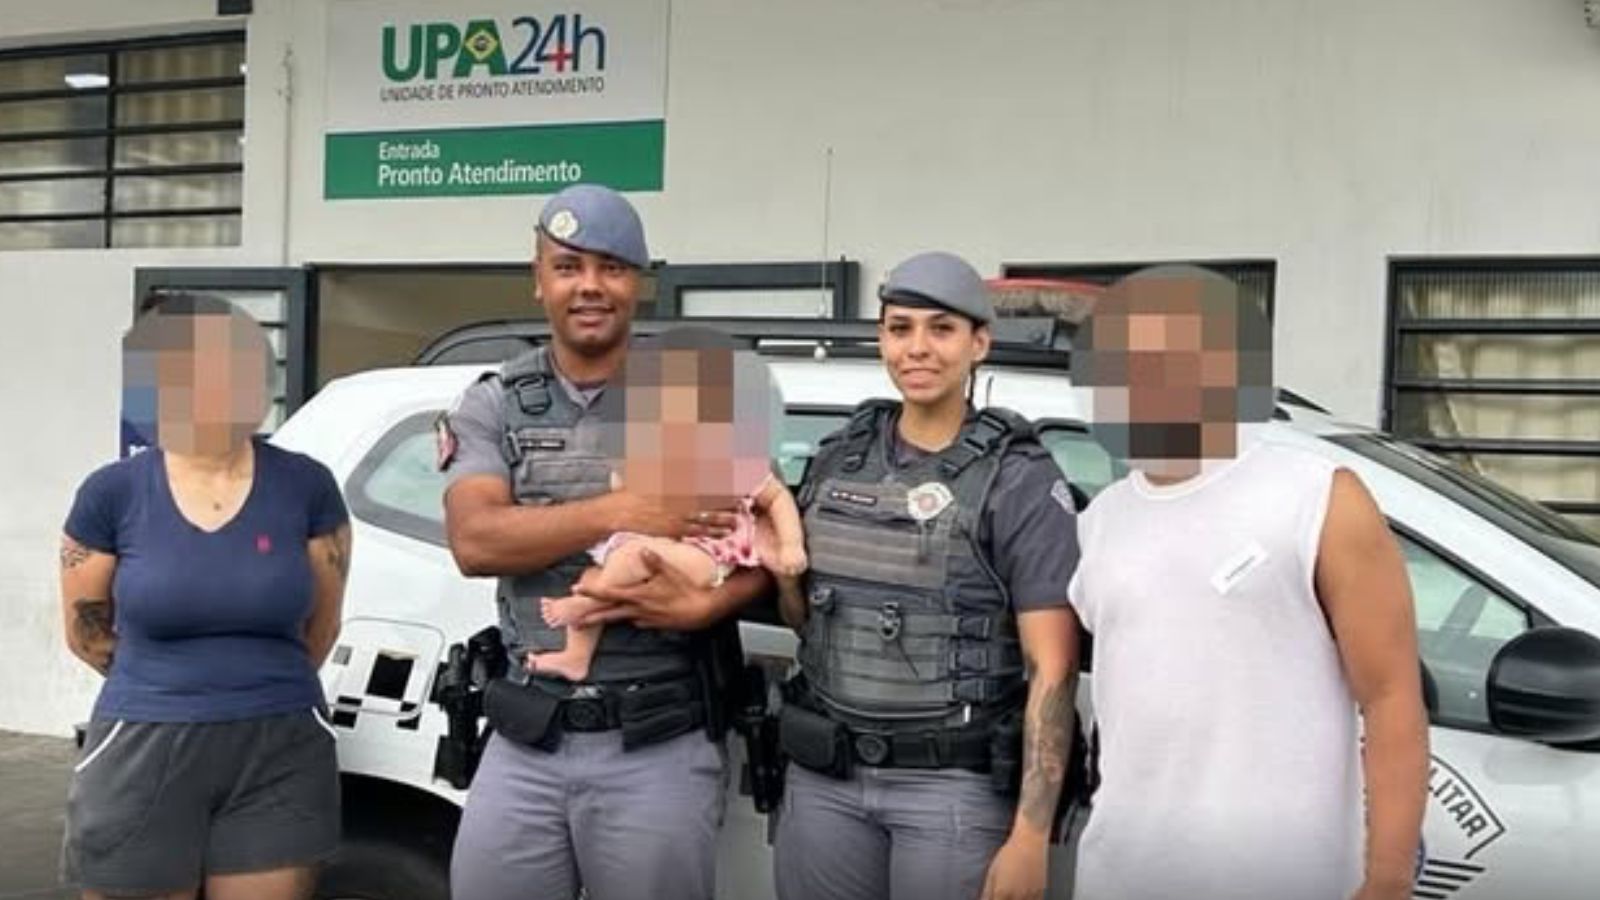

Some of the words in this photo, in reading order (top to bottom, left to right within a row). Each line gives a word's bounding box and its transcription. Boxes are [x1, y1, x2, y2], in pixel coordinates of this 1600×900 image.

[379, 85, 434, 102] UNIDADE
[437, 83, 454, 101] DE
[457, 80, 509, 99] PRONTO
[511, 76, 604, 97] ATENDIMENTO
[378, 140, 440, 161] Entrada
[377, 163, 443, 188] Pronto
[447, 160, 582, 185] Atendimento
